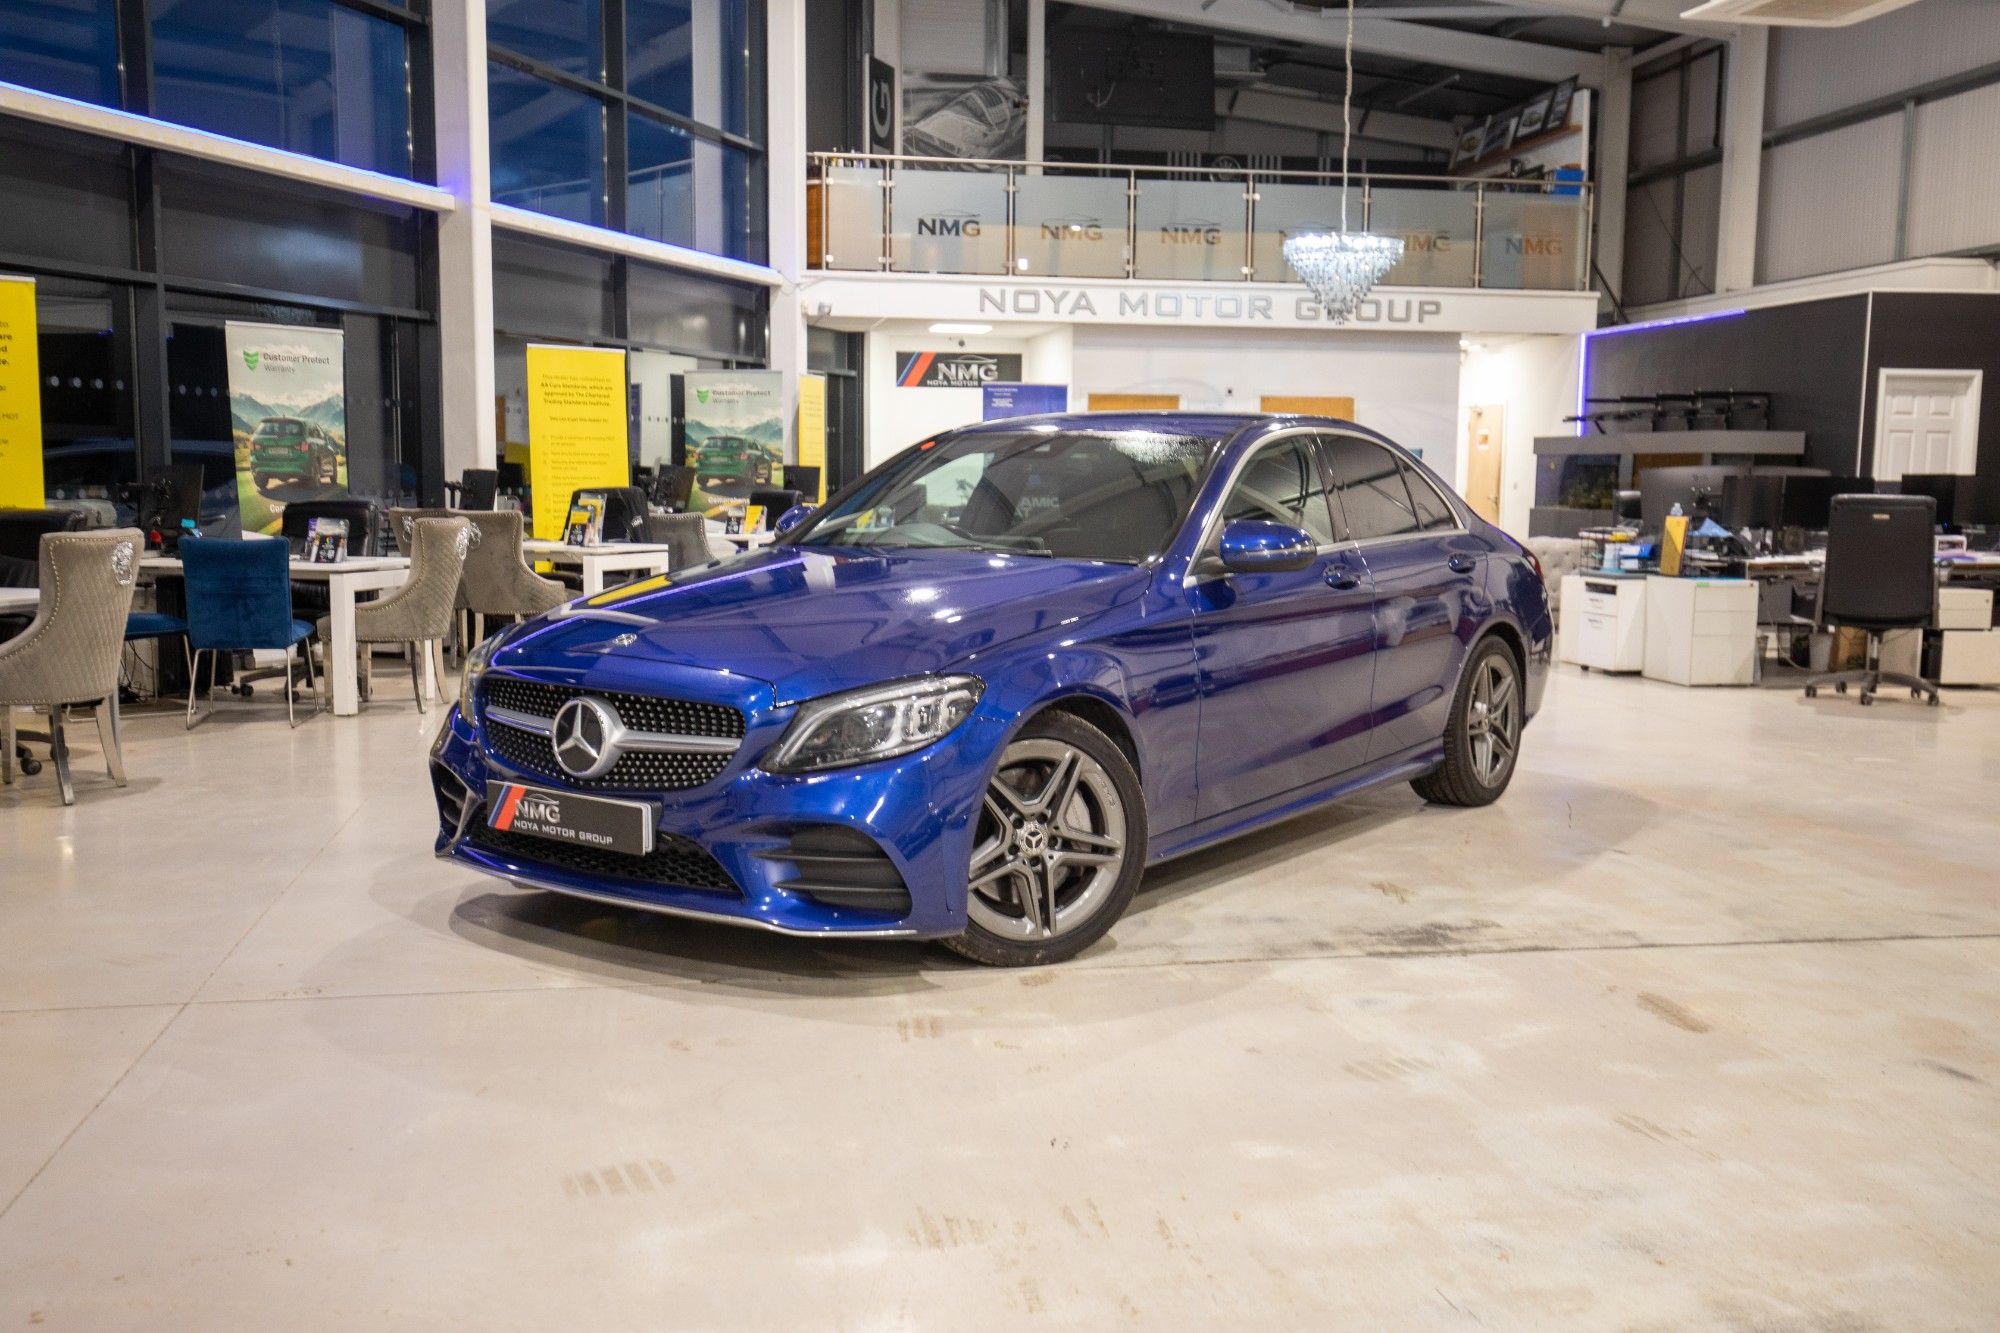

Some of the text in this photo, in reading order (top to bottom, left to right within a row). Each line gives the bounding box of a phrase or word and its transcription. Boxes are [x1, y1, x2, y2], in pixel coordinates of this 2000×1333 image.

[918, 218, 981, 237] NMG
[1041, 223, 1103, 241] NMG
[1161, 227, 1222, 245] NMG
[1505, 236, 1563, 255] NMG
[979, 288, 1441, 323] NOYA MOTOR GOUP
[263, 352, 330, 365] Customer Protect
[937, 361, 999, 382] NMG
[926, 379, 979, 387] NOYA MOTOR
[514, 799, 561, 824] NMG
[514, 819, 613, 845] NOYA MOTOR GROUP
